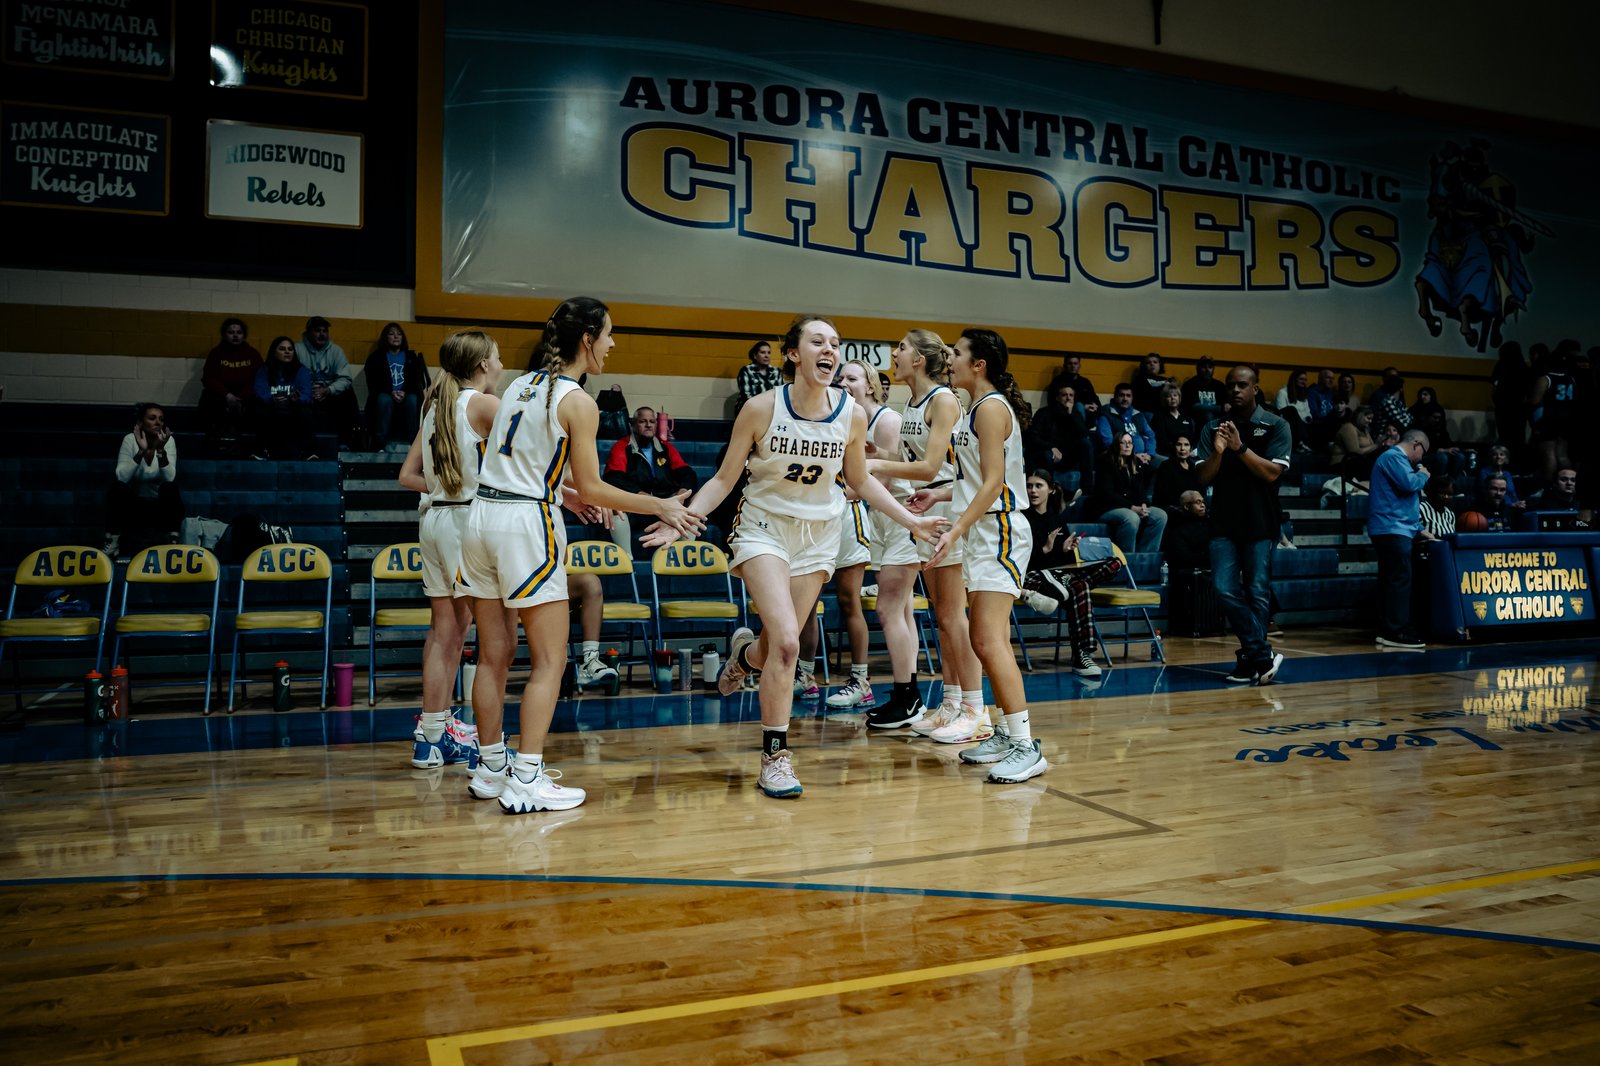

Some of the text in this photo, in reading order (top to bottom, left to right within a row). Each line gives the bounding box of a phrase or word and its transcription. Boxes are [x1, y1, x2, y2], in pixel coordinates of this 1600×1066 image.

[250, 8, 332, 34] CHICAGO
[236, 28, 345, 56] CHRISTIAN
[242, 49, 338, 87] Knights
[10, 121, 159, 153] IMMACULATE
[619, 76, 1400, 202] AURORA CENTRAL CATHOLIC
[15, 145, 150, 172] CONCEPTION
[30, 165, 137, 204] Knights
[247, 176, 325, 207] Rebels
[620, 121, 1401, 291] CHARGERS
[840, 342, 881, 367] ORS
[497, 410, 524, 459] 1
[770, 436, 843, 458] CHARGERS
[783, 463, 824, 485] 23
[33, 551, 98, 577] ACC
[141, 549, 204, 574] ACC
[257, 548, 316, 572] ACC
[387, 548, 422, 571] AC
[570, 545, 619, 567] ACC
[665, 545, 715, 567] ACC
[1483, 551, 1557, 568] WELCOME TO
[1461, 568, 1588, 595] AURORA CENTRAL
[1495, 594, 1565, 620] CATHOLIC
